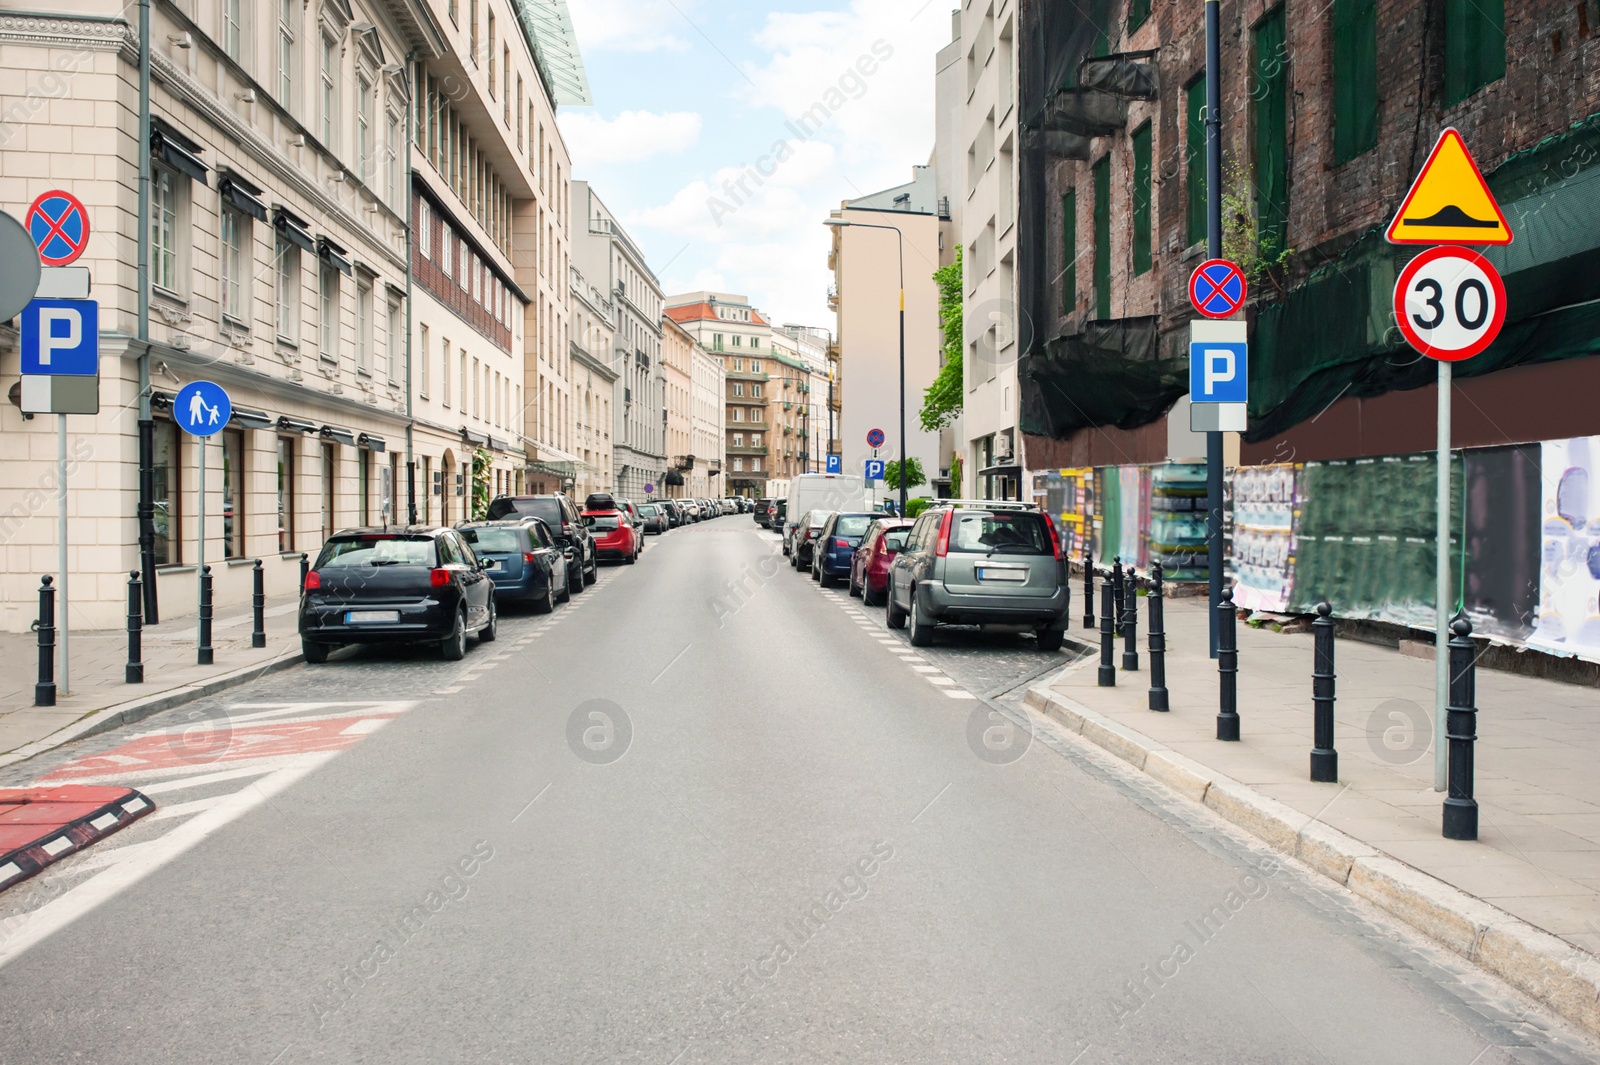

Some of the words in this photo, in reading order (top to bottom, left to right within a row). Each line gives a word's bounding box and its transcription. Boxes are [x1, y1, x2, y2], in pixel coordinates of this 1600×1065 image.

[1412, 278, 1489, 331] 30
[39, 307, 82, 365] P
[1204, 349, 1236, 395] P
[829, 456, 838, 468] P
[869, 462, 881, 477] P
